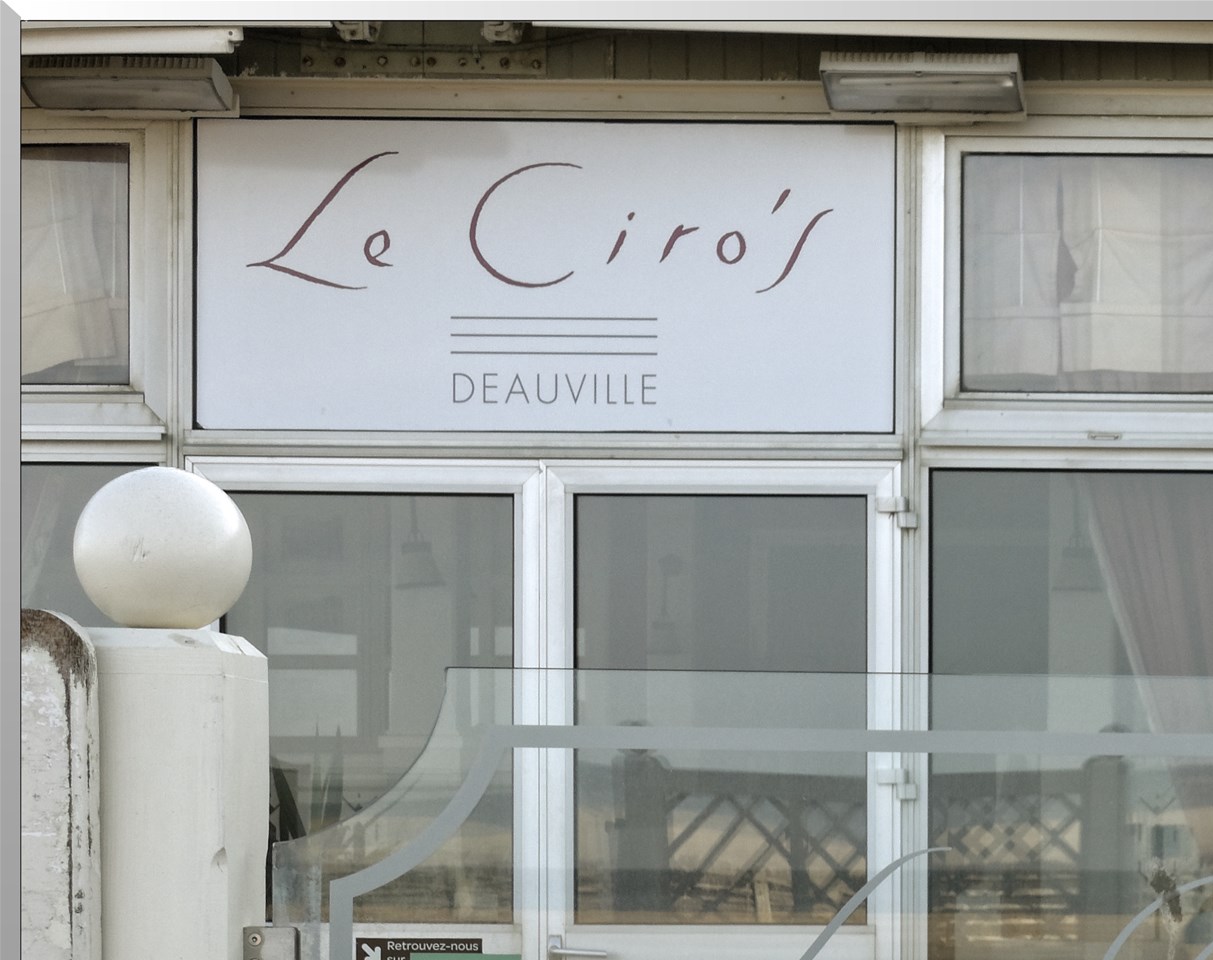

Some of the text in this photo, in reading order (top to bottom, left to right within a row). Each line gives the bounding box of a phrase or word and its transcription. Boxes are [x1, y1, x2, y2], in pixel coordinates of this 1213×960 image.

[247, 152, 834, 293] Le Ciro's
[452, 372, 657, 406] DEAUVILLE
[387, 941, 479, 951] Retrouvez-nous
